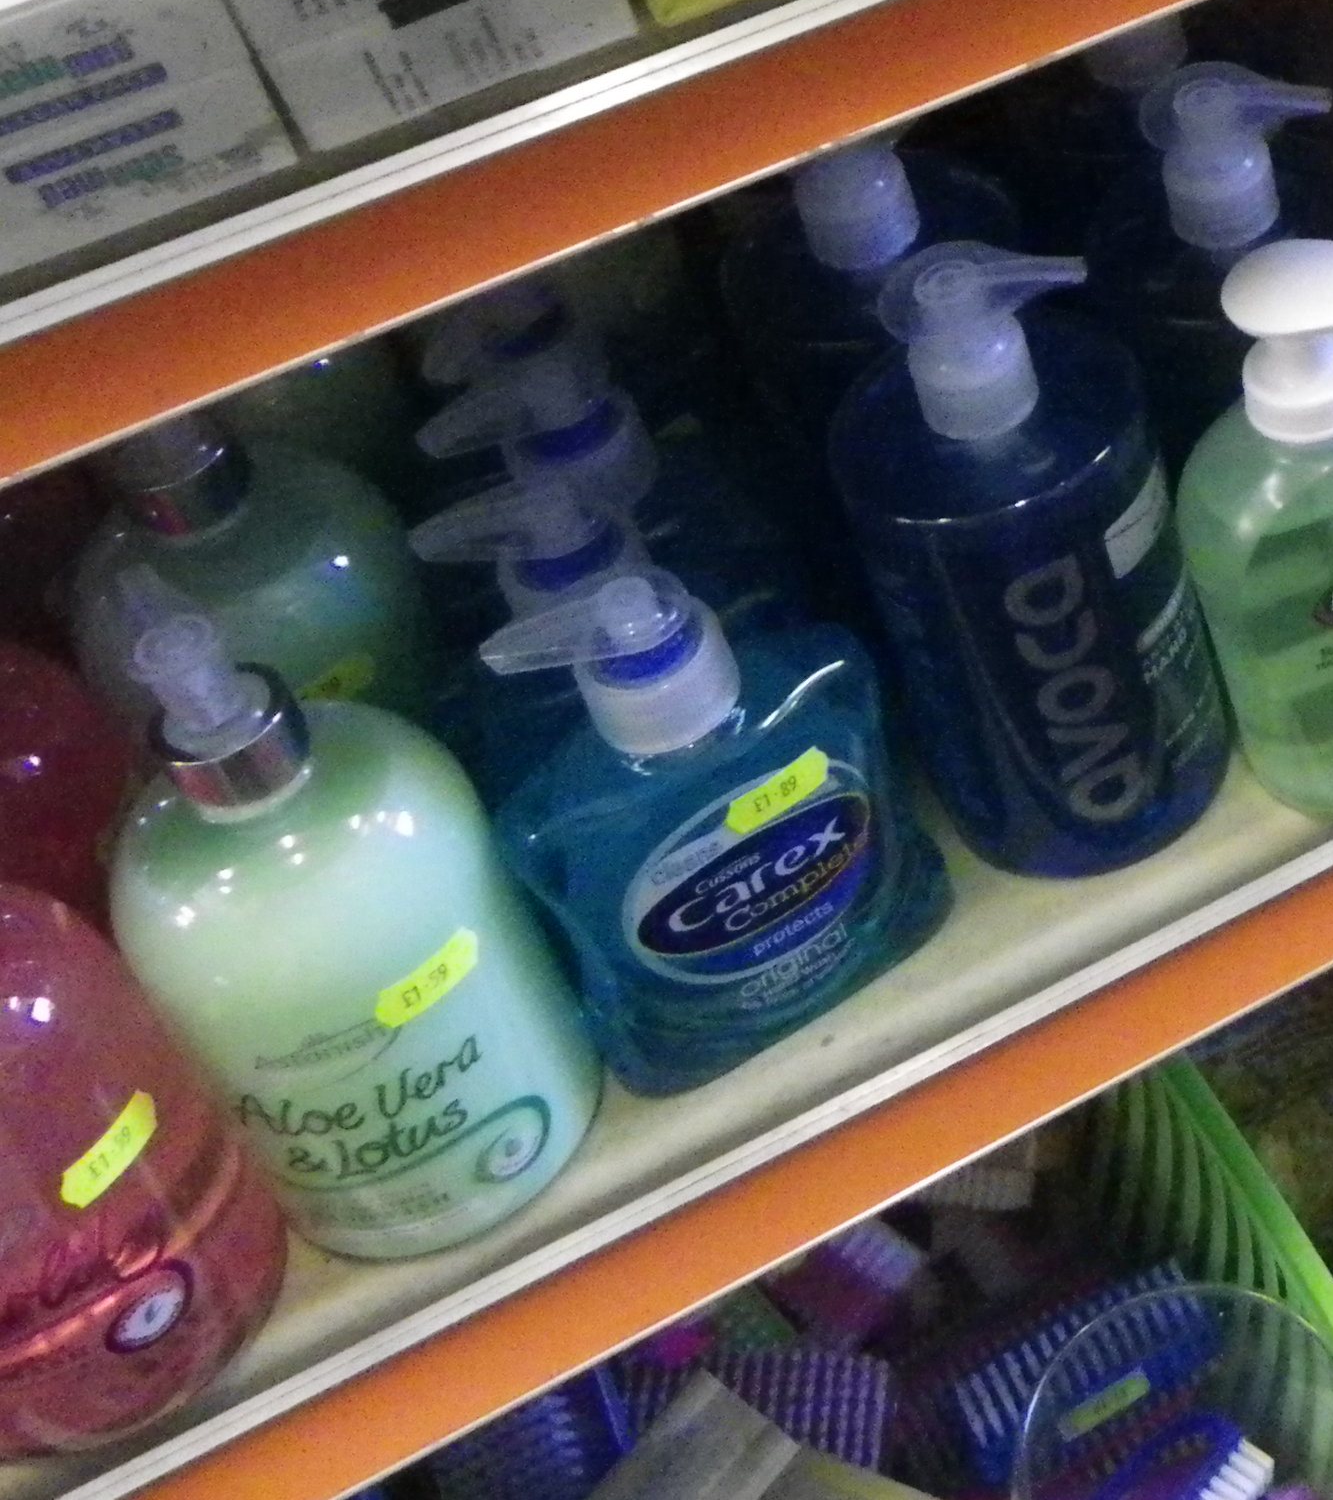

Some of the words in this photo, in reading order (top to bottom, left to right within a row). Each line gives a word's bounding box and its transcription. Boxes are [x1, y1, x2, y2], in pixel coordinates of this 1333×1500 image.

[753, 775, 797, 812] £1.89
[668, 815, 846, 932] Carex
[695, 853, 761, 894] Cussons
[740, 923, 848, 997] original
[753, 901, 835, 956] protects
[237, 1093, 365, 1137] Aloe
[375, 1035, 483, 1117] Vera
[286, 1152, 327, 1174] &
[335, 1100, 469, 1179] Lotus
